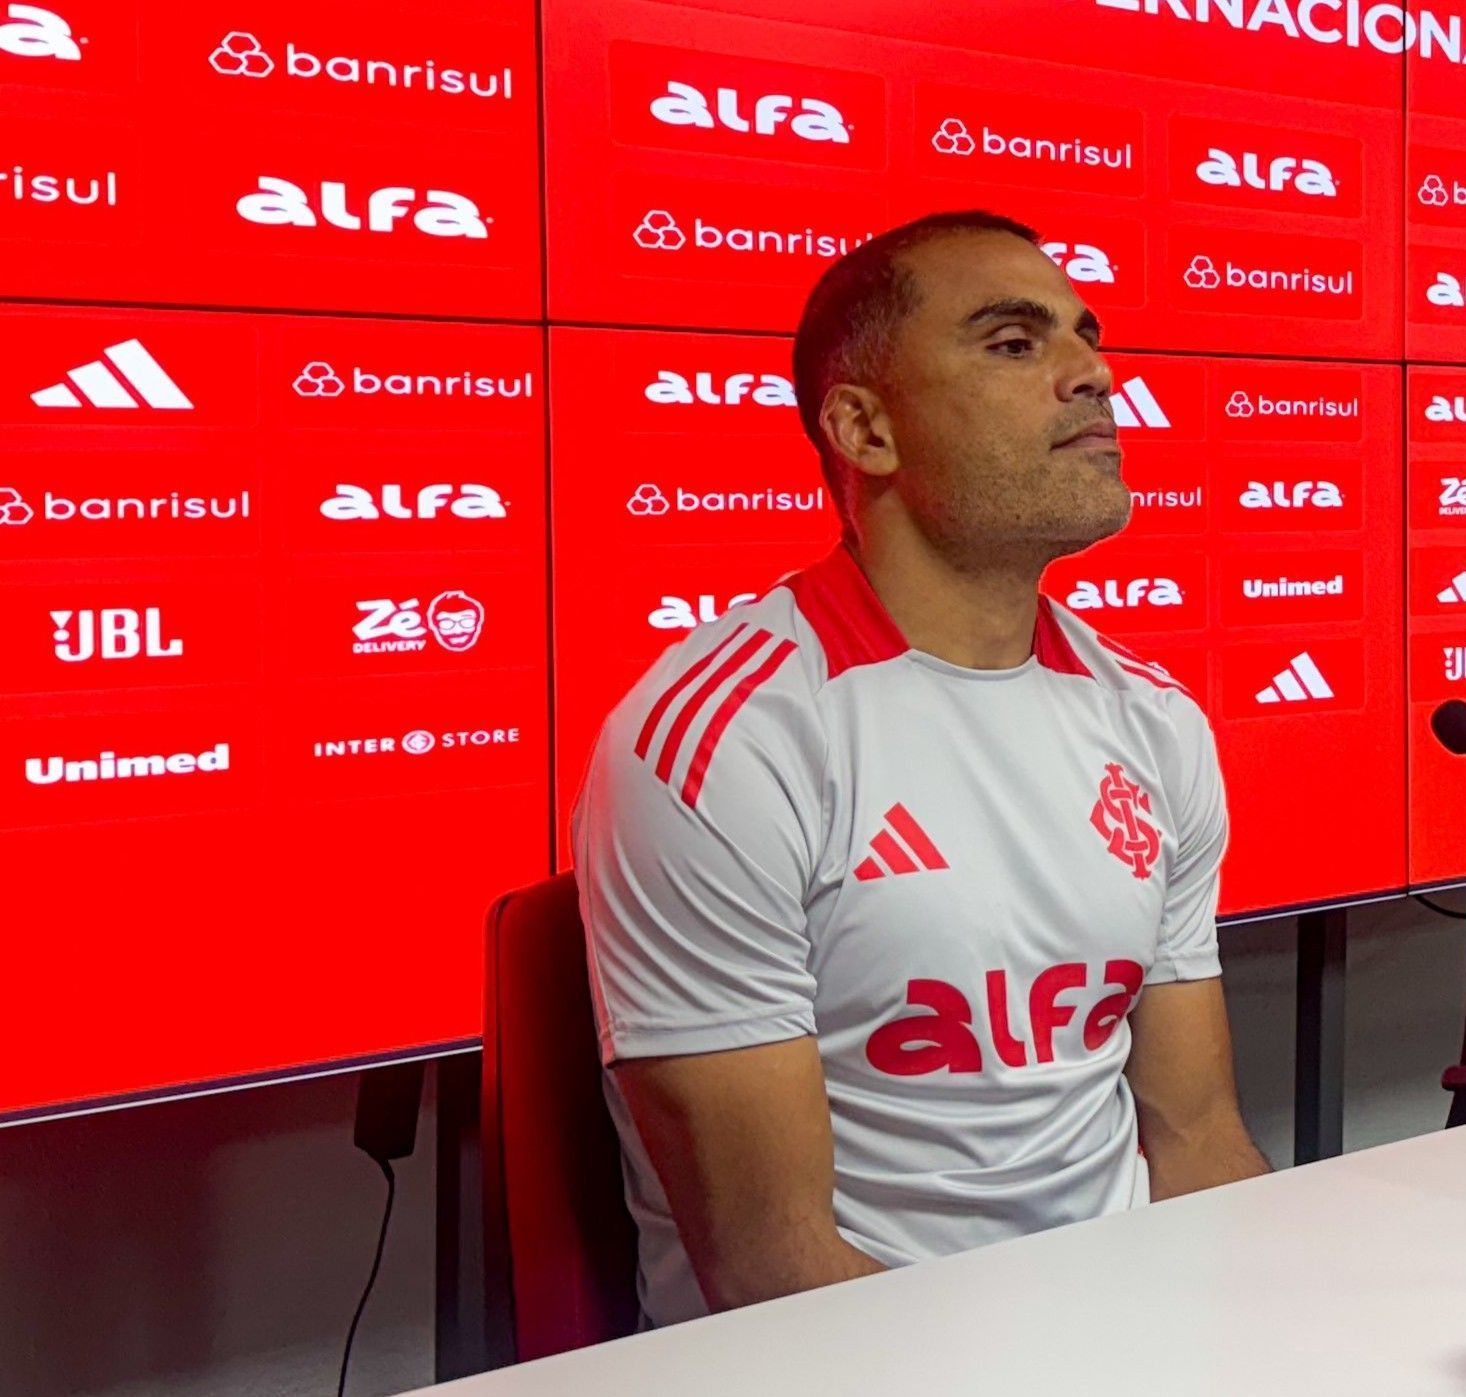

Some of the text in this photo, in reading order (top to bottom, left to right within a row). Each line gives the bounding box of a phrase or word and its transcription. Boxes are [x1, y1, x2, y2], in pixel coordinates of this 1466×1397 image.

[286, 43, 512, 99] banrisul
[983, 127, 1131, 169] banrisul
[0, 166, 116, 206] isul
[695, 218, 873, 257] banrisu
[1226, 262, 1352, 294] banrisul
[353, 367, 532, 397] banrisul
[1258, 395, 1358, 417] banrisul
[44, 491, 249, 520] banrisul
[677, 487, 823, 511] banrisul
[1131, 487, 1201, 507] nrisul
[1242, 575, 1344, 598] Unimed
[352, 598, 426, 638] Zé
[50, 607, 183, 662] JBL
[352, 640, 426, 654] DELIVERY
[314, 728, 520, 757] INTER STORE
[25, 743, 230, 785] Unimed
